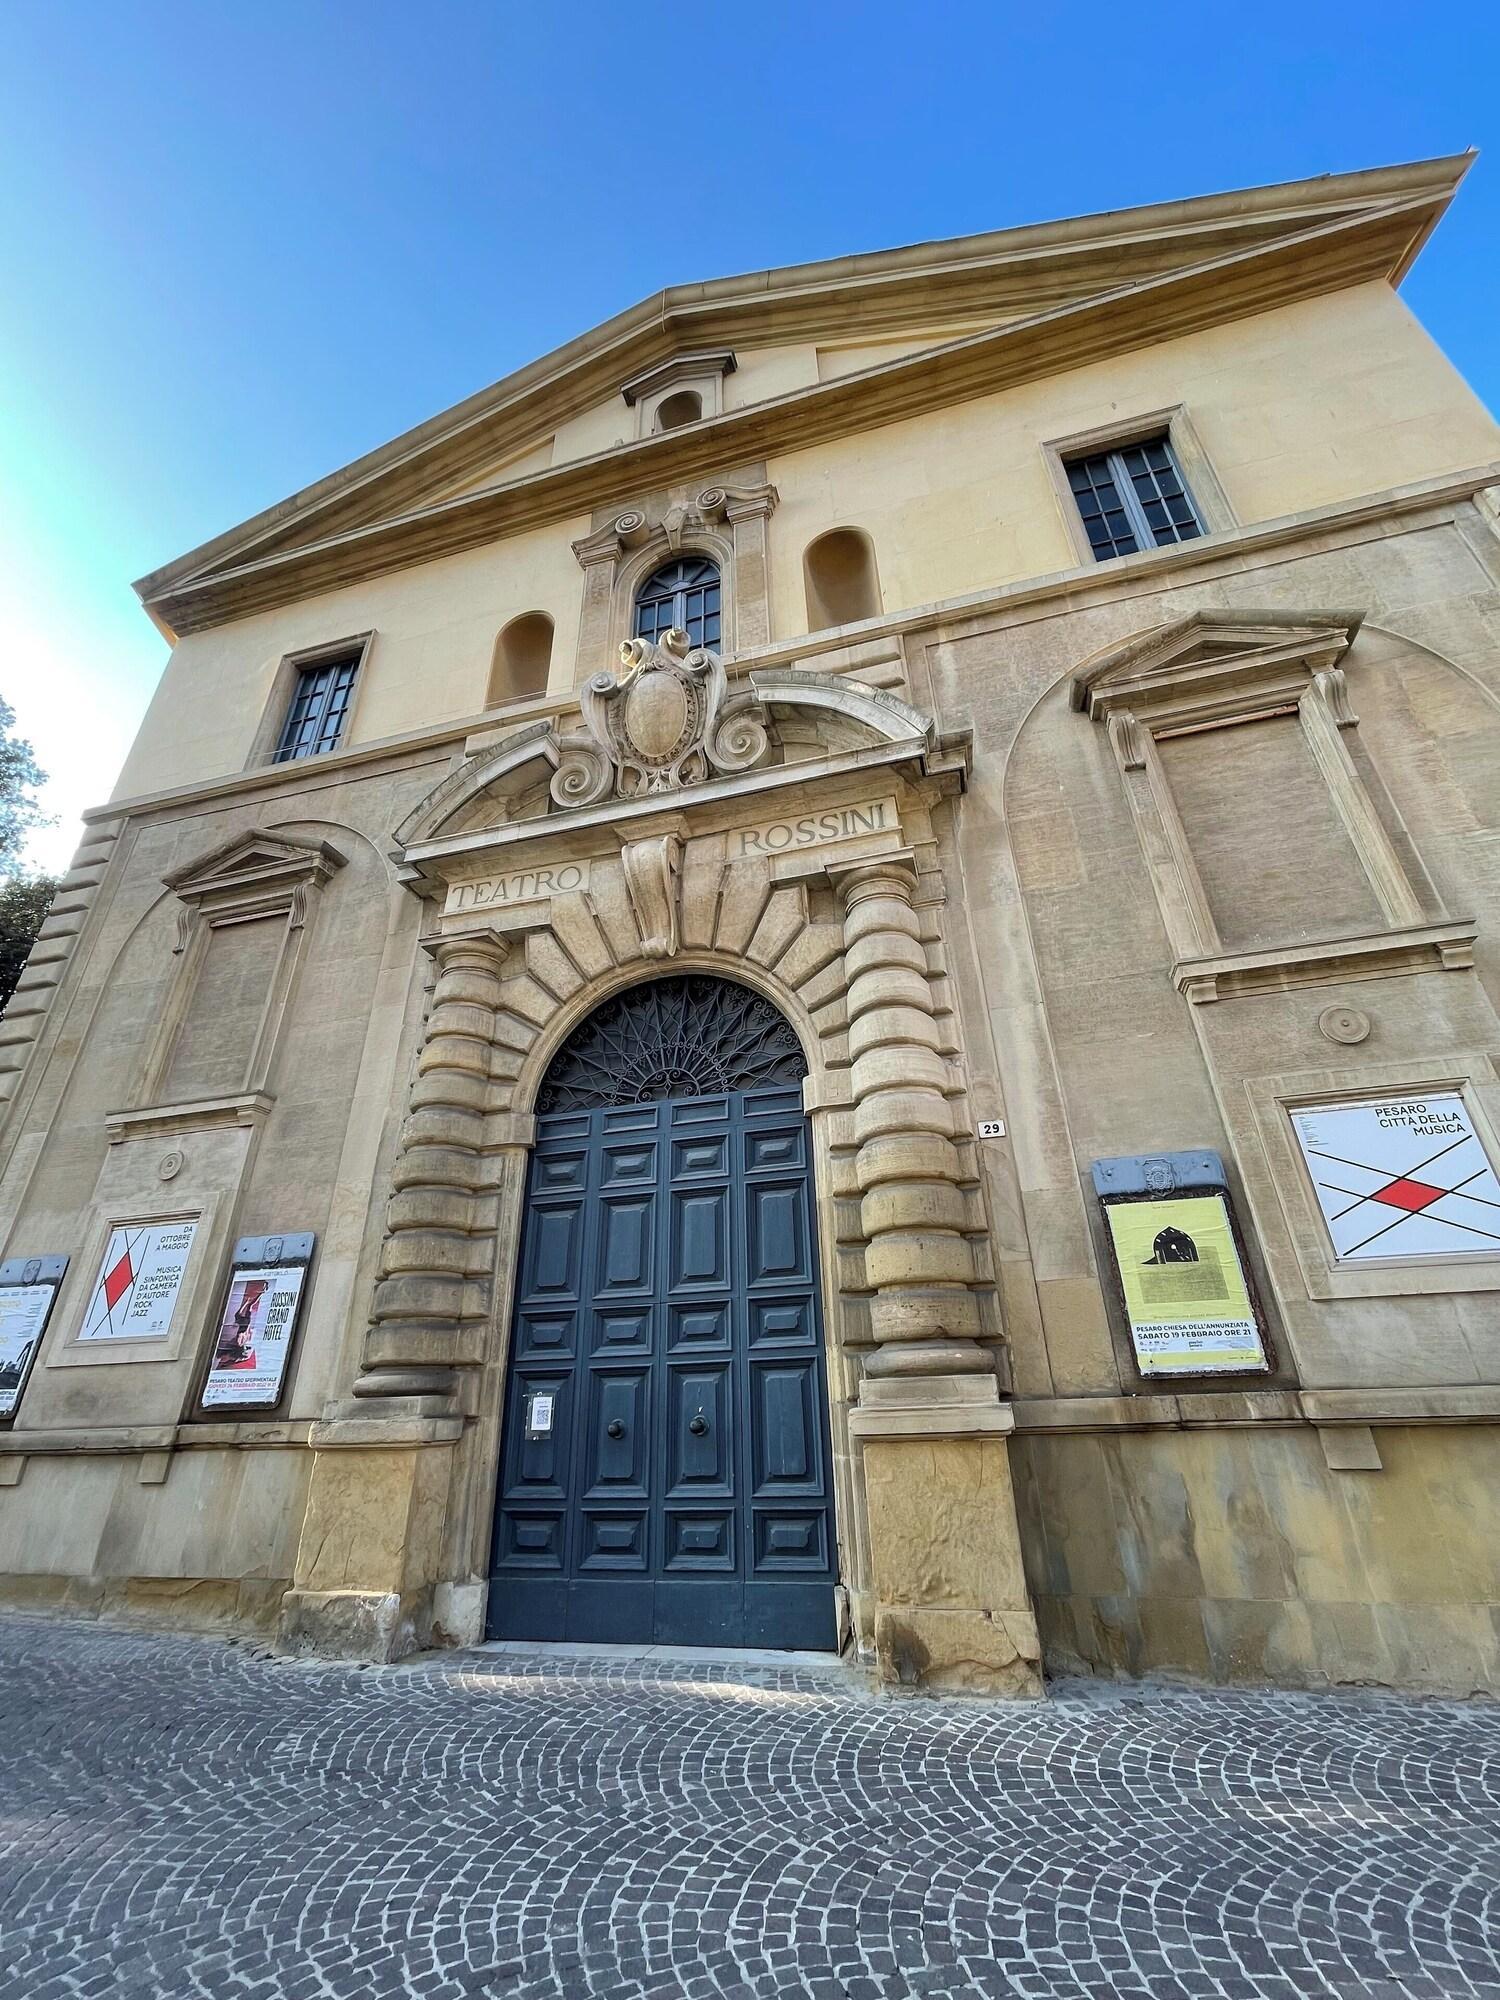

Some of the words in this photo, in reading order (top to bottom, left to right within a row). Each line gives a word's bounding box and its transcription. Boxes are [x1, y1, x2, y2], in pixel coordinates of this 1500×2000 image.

[452, 866, 582, 908] TEATRO
[739, 803, 886, 856] ROSSINI
[1374, 1104, 1427, 1118] PESARO
[1379, 1114, 1416, 1128] CITTÀ
[1419, 1112, 1461, 1124] DELLA
[984, 1124, 1000, 1134] 29
[1413, 1123, 1466, 1137] MUSICA
[160, 1234, 191, 1243] OTTOBRE
[161, 1242, 189, 1250] MAGGIO
[156, 1266, 182, 1274] MUSICA
[143, 1274, 179, 1284] SINFONICA
[149, 1282, 177, 1290] CAMERA
[136, 1291, 170, 1300] D'AUTORE
[270, 1291, 298, 1308] ROSSINI
[133, 1301, 153, 1309] ROCK
[131, 1309, 149, 1317] JAZZ
[266, 1308, 290, 1324] GRAND
[1188, 1322, 1249, 1330] DELL'ANNUNZIATA
[263, 1324, 283, 1340] HOTEL
[1137, 1332, 1170, 1340] SABATO
[1181, 1329, 1222, 1338] FEBBRAIO
